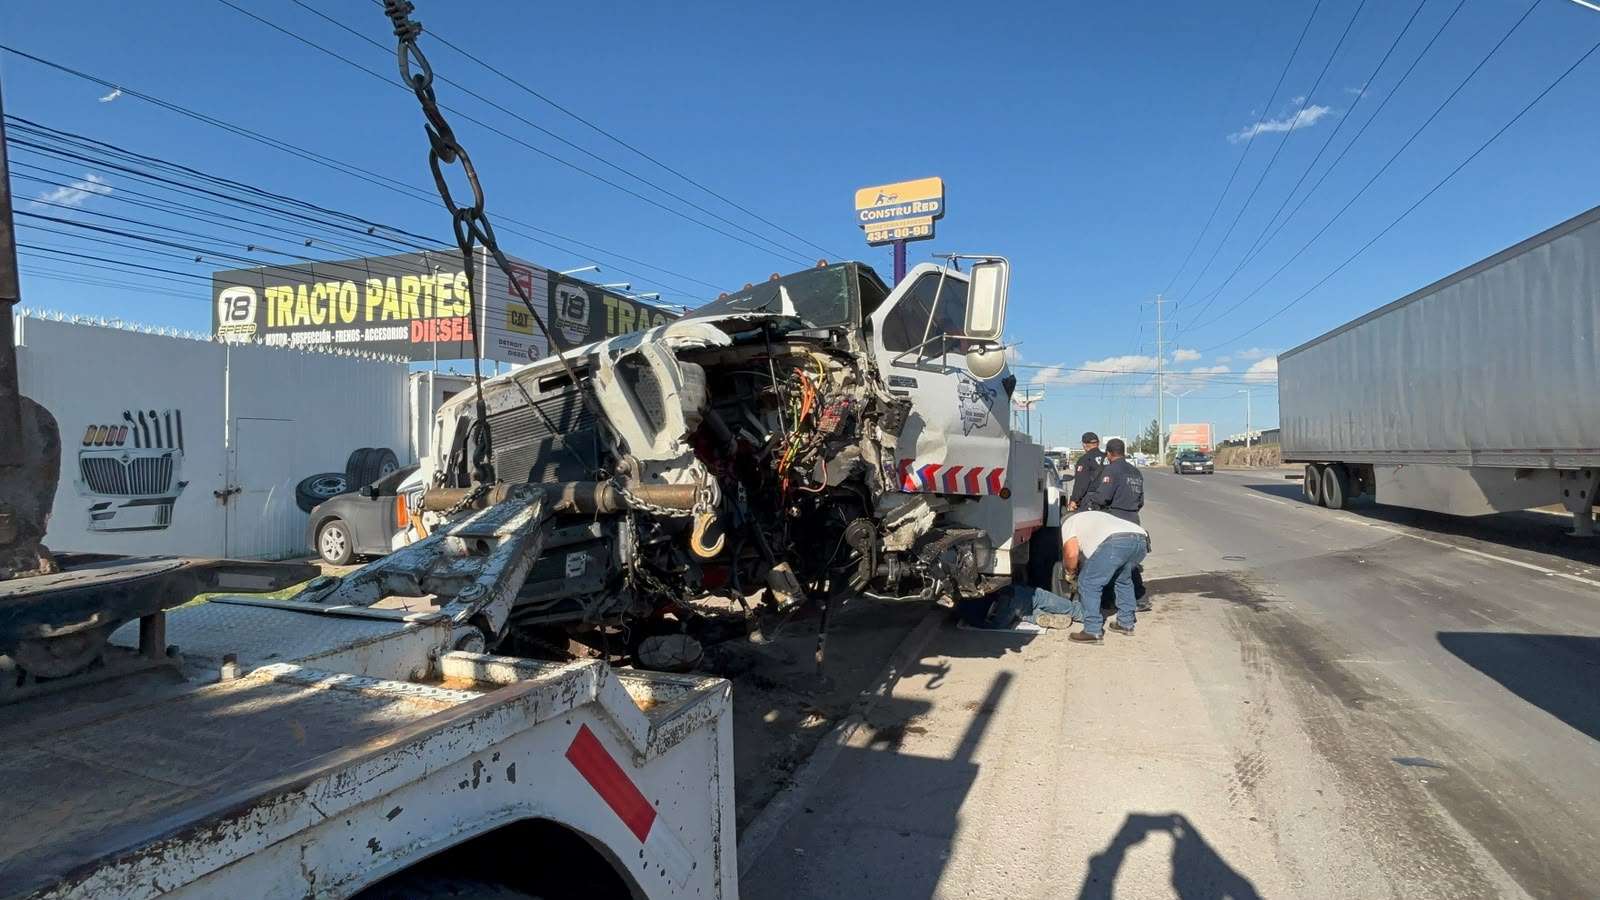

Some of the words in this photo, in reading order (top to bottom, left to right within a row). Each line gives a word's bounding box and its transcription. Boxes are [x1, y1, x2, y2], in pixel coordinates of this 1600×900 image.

[223, 296, 251, 322] 18
[264, 281, 359, 328] TRACTO
[365, 271, 471, 322] PARTES
[560, 290, 586, 320] 18
[411, 317, 474, 344] DIESEL
[511, 310, 529, 328] CAT
[335, 329, 361, 342] FRENOS
[364, 326, 409, 341] ACCESORIOS
[498, 338, 523, 349] DETROIT
